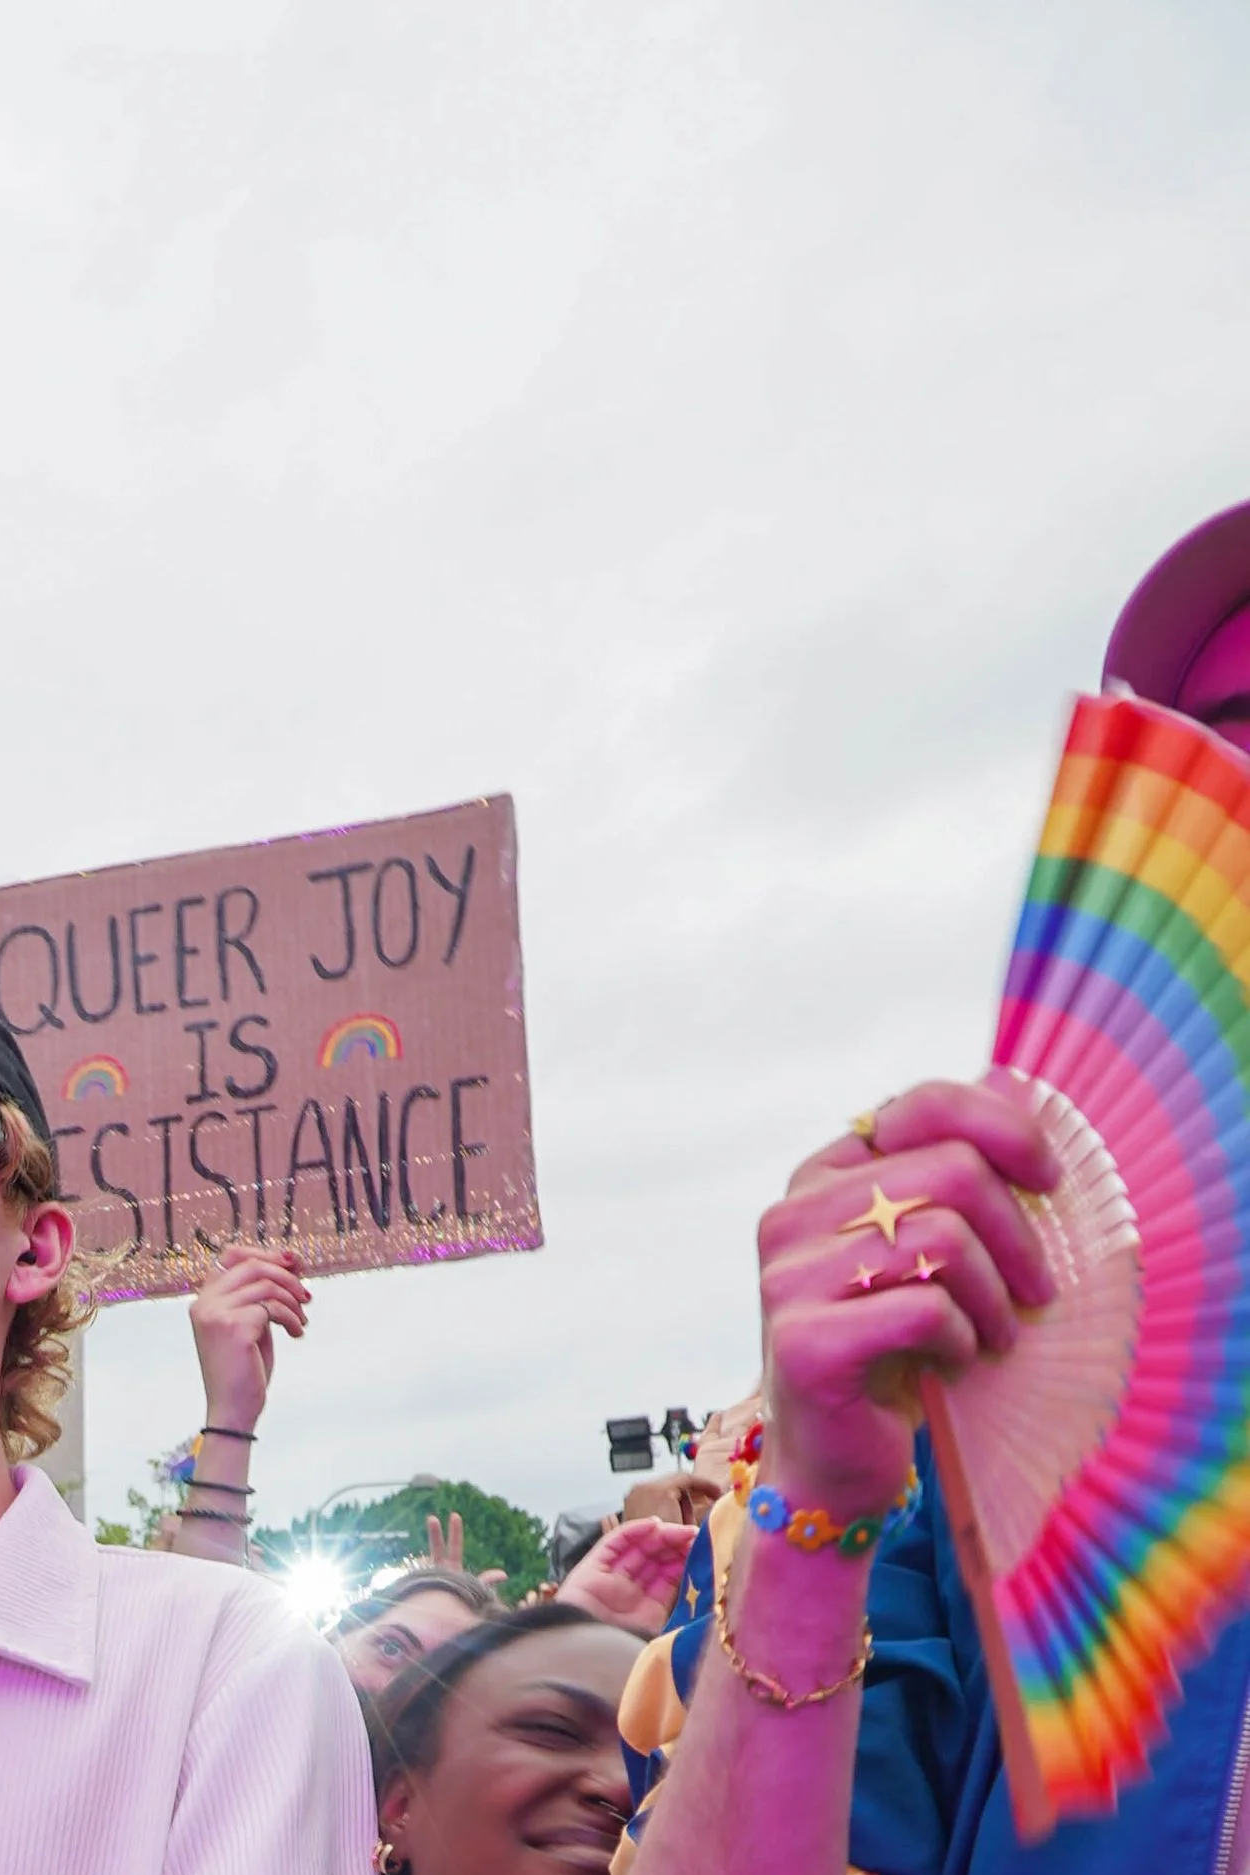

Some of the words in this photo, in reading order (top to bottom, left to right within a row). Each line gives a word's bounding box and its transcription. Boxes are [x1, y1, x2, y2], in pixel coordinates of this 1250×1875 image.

[307, 844, 476, 981] JOY
[183, 1014, 278, 1105] IS
[50, 1076, 488, 1260] ESISTANCE
